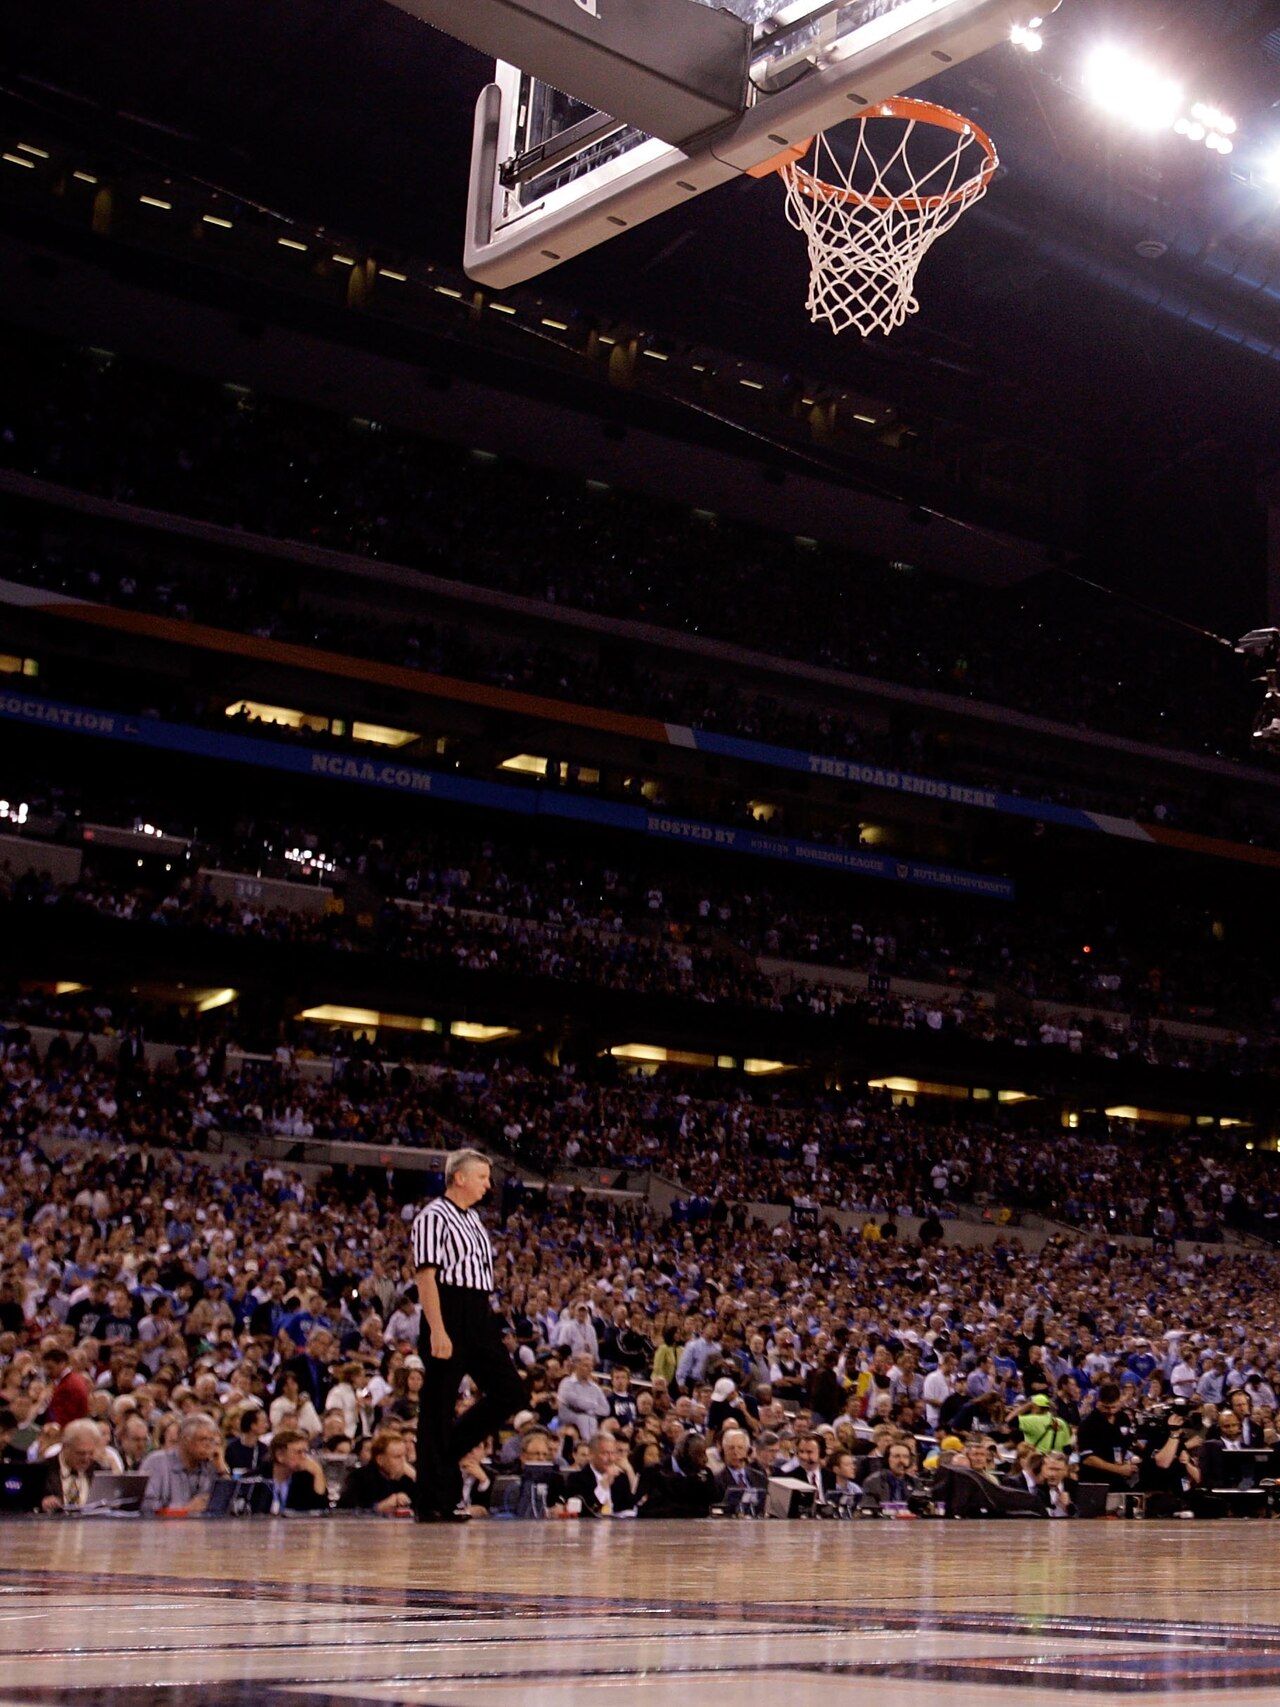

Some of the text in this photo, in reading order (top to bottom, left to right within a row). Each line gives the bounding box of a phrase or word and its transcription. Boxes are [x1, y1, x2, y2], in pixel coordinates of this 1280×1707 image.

[312, 754, 432, 791] NCAA.COM
[808, 755, 997, 808] THE ROAD ENDS HERE
[648, 817, 736, 844] HOSTED BY
[796, 846, 884, 871] HORIZON LEAGUE
[913, 868, 1012, 895] BUTLER UNIVERSITY
